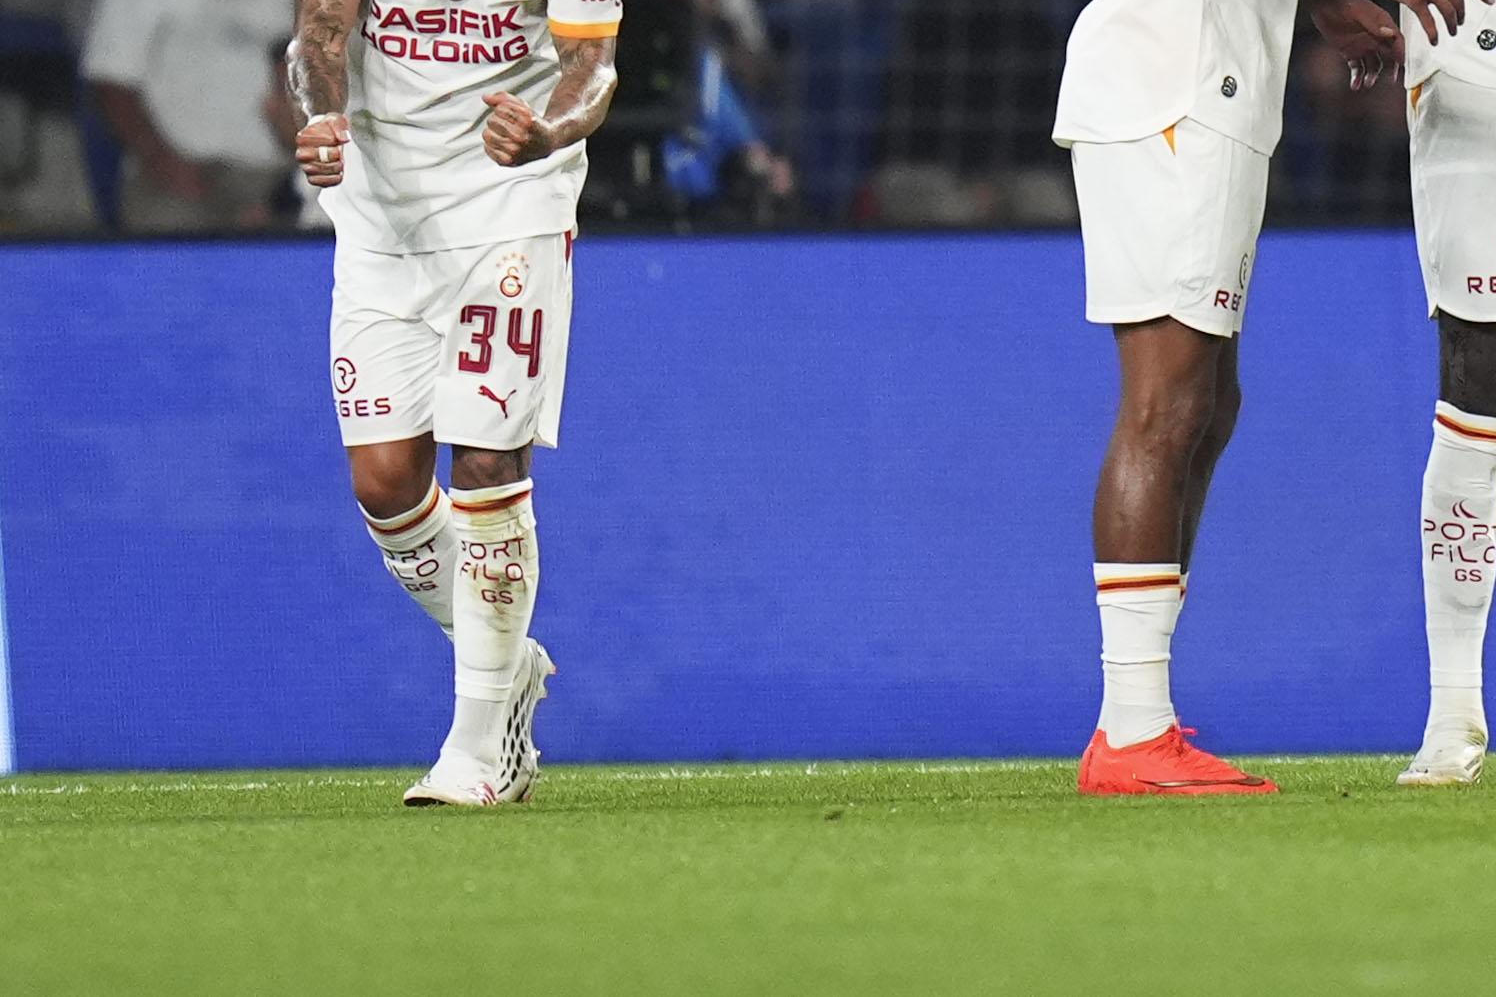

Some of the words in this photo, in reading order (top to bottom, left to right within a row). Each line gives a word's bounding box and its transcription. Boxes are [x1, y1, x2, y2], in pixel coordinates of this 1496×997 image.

[458, 304, 543, 378] 34
[334, 397, 392, 418] GES
[1455, 568, 1483, 582] GS
[480, 588, 514, 605] GS
